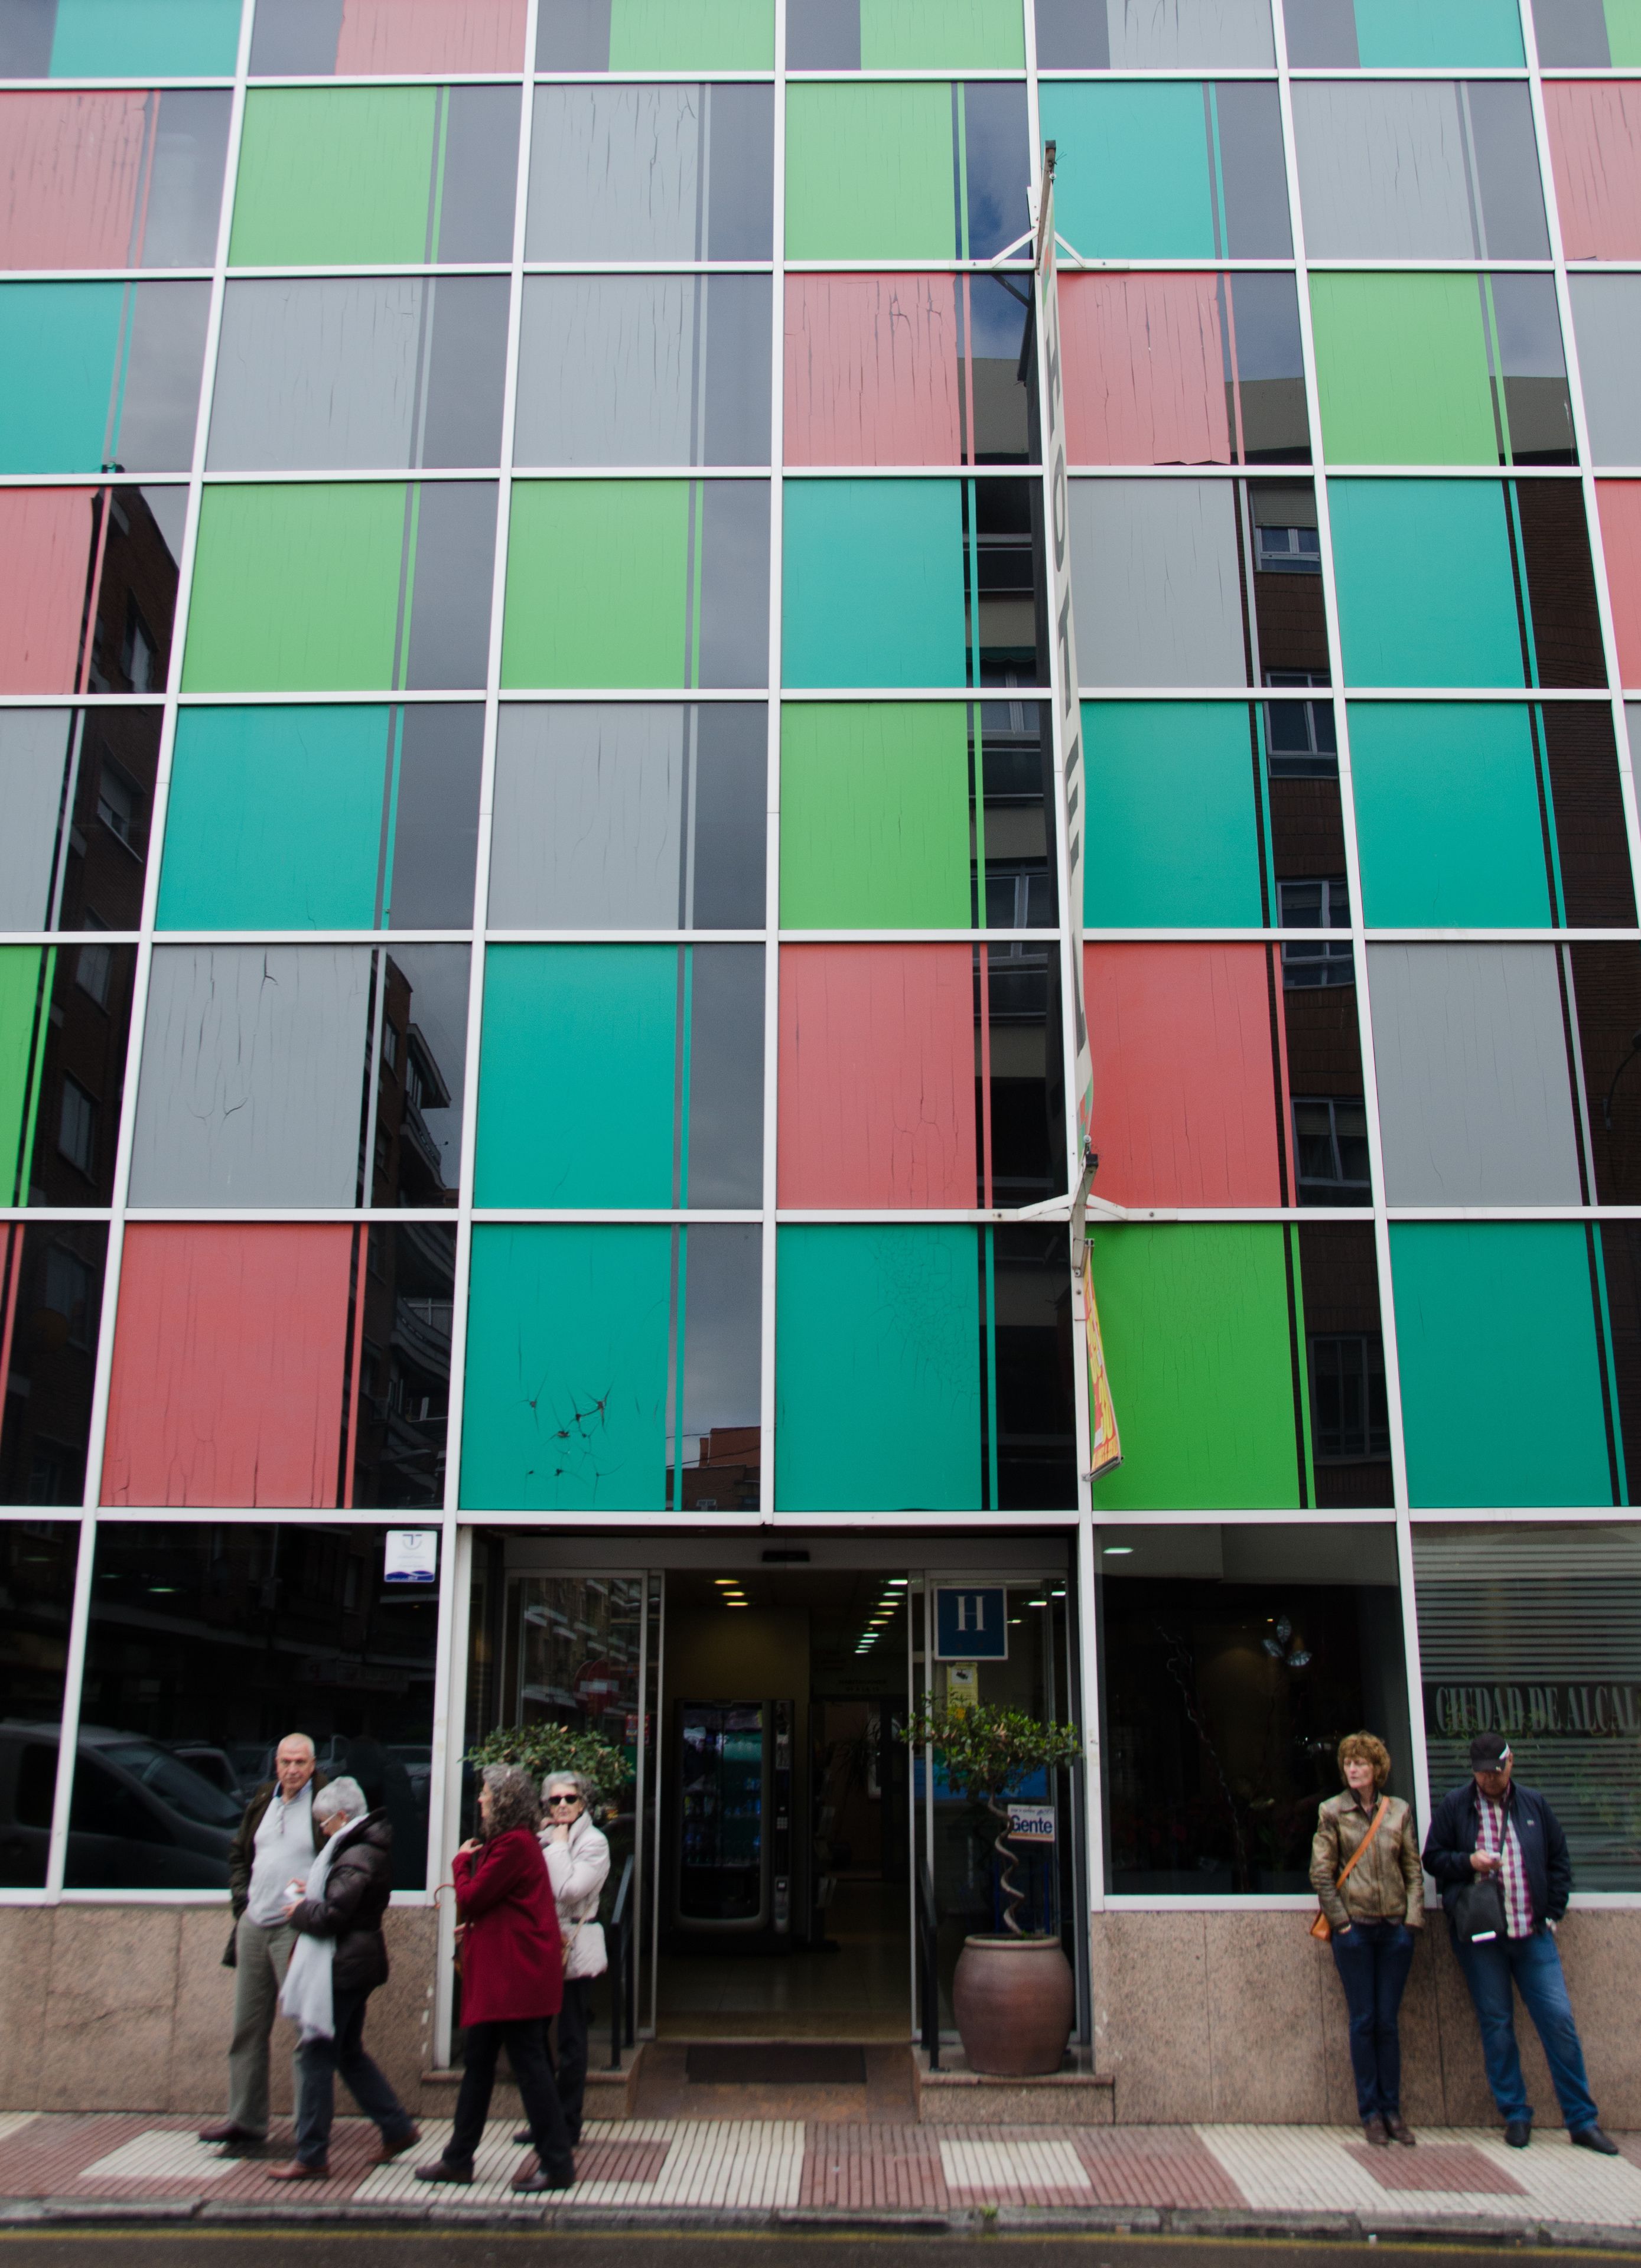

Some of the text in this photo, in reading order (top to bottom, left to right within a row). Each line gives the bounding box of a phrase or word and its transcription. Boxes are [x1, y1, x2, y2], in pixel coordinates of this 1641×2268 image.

[1046, 289, 1086, 1057] HOTEL
[955, 1595, 986, 1631] H
[1435, 1686, 1524, 1732] CIUDAD
[1528, 1686, 1561, 1731] DE
[1011, 1814, 1053, 1834] Gente
